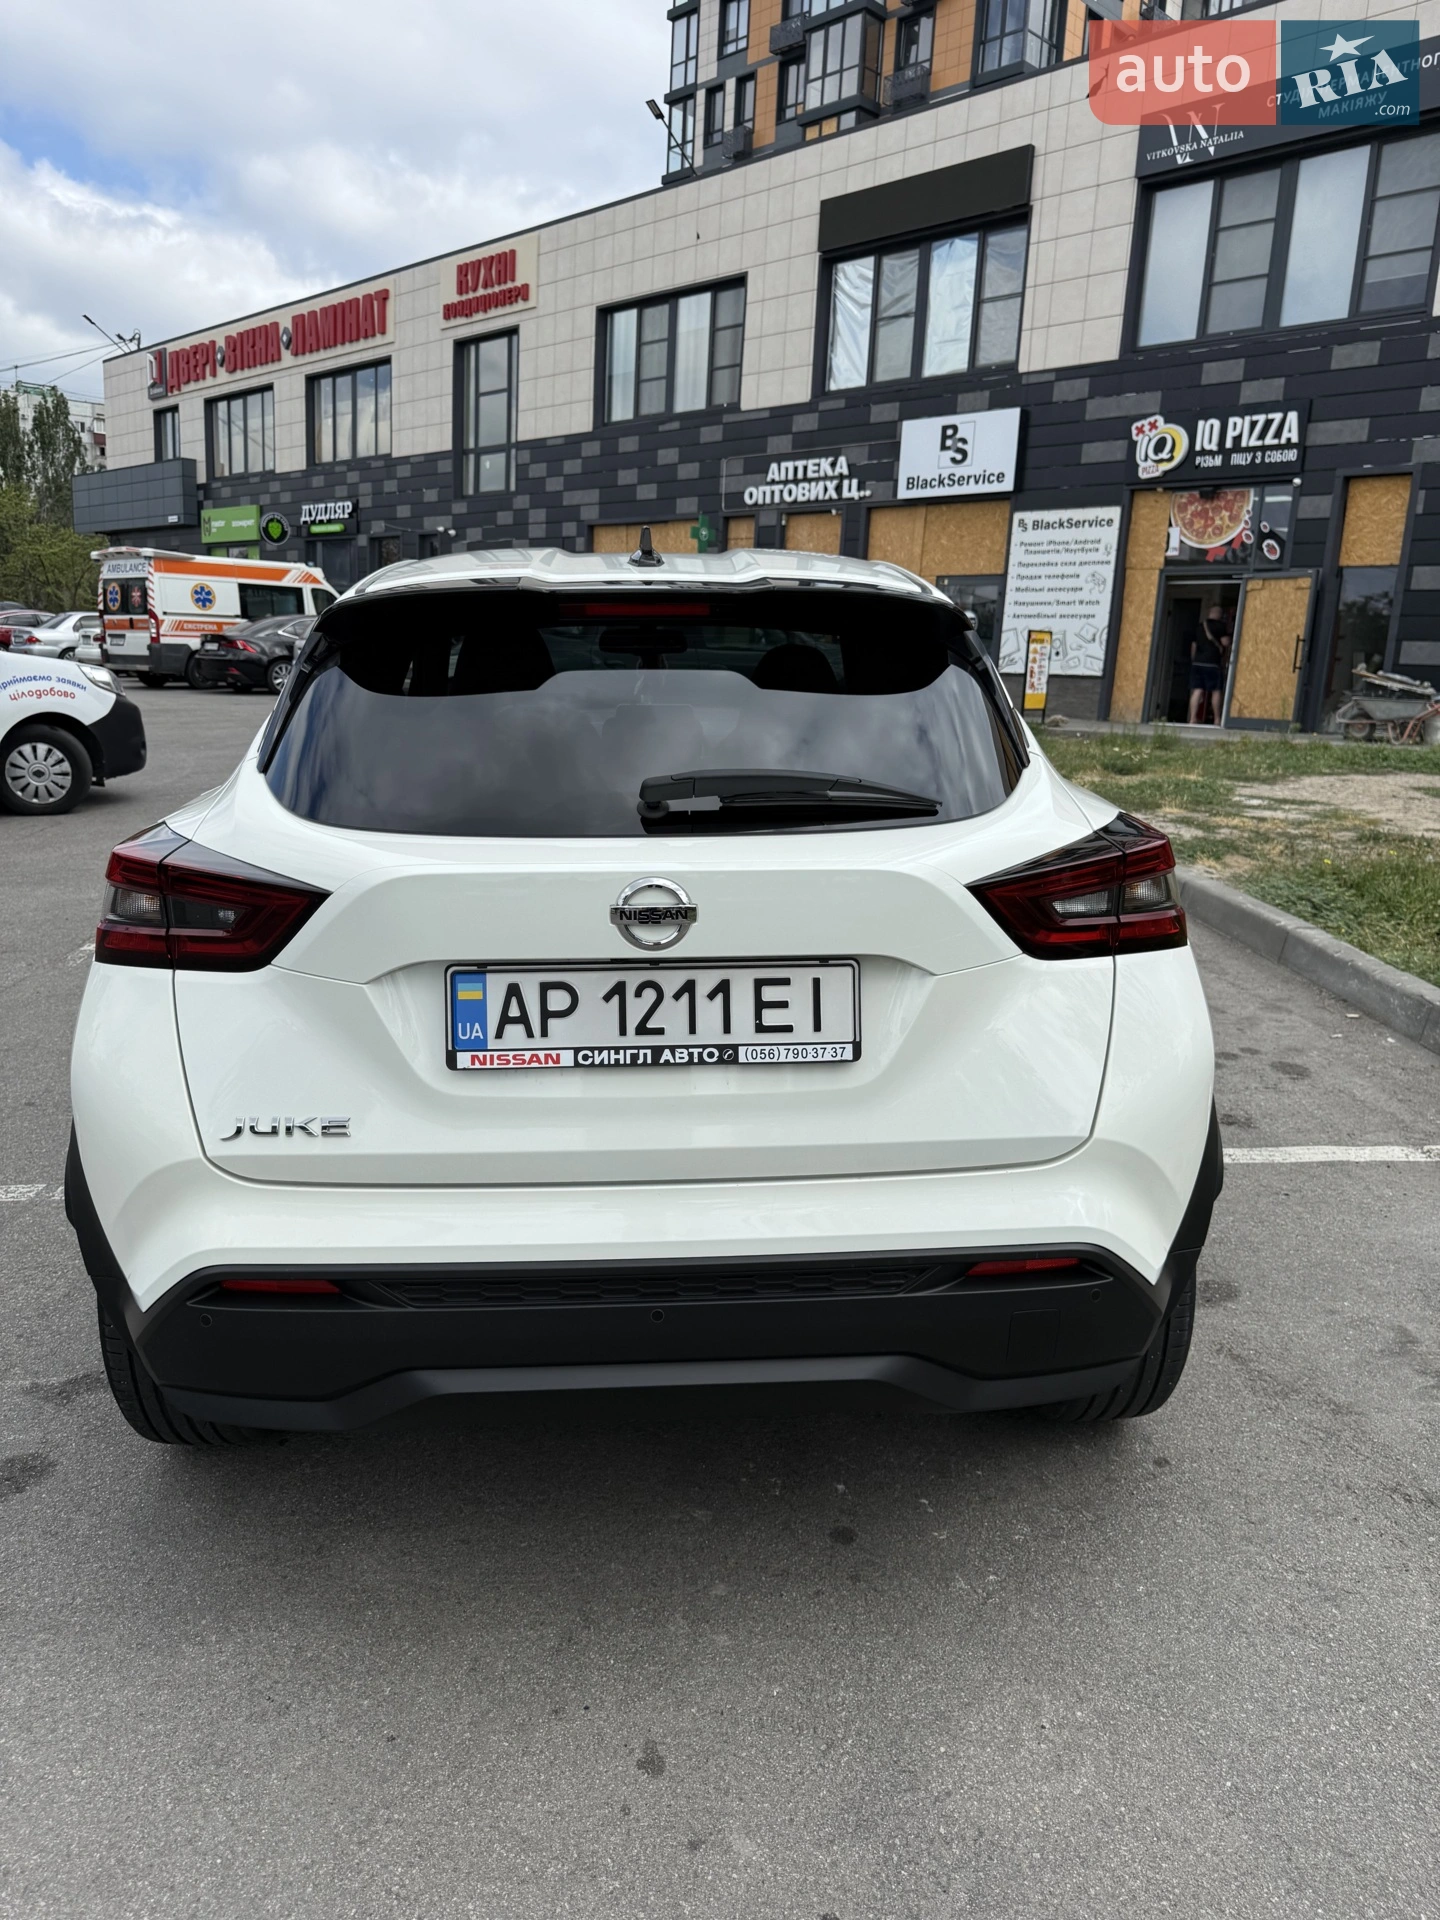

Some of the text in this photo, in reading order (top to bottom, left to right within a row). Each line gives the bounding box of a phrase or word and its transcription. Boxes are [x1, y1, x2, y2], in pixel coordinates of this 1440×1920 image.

[1146, 130, 1244, 161] VITKOVSKA NATALIIA
[456, 249, 516, 296] КУХНІ
[443, 283, 529, 321] КОНДИЦІОНЕРИ
[167, 288, 390, 394] ДВЕРІ ВІКНА ЛАМІНАТ
[1195, 410, 1299, 451] IQ PIZZA
[1137, 433, 1175, 462] IQ
[1230, 452, 1253, 466] ПІЦУ
[1265, 449, 1297, 463] СОБОЮ
[766, 455, 849, 483] АПТЕКА
[905, 469, 1005, 491] BlackService
[1141, 464, 1160, 476] PIZZA
[743, 480, 841, 506] ОПТОВИХ
[300, 500, 353, 525] ДУДЛЯР
[1032, 516, 1114, 531] BlackService
[106, 562, 148, 574] AMBULANCE
[183, 622, 218, 632] ЕКСТРЕНА
[9, 686, 76, 702] цілодобово
[55, 675, 87, 692] заявки
[619, 908, 689, 923] NISSAN
[458, 1023, 484, 1040] UA
[602, 978, 732, 1036] 1211
[470, 1052, 562, 1067] NISSAN
[577, 1048, 653, 1065] СИНГЛ
[659, 1047, 719, 1064] АВТО
[220, 1116, 351, 1142] JUKE
